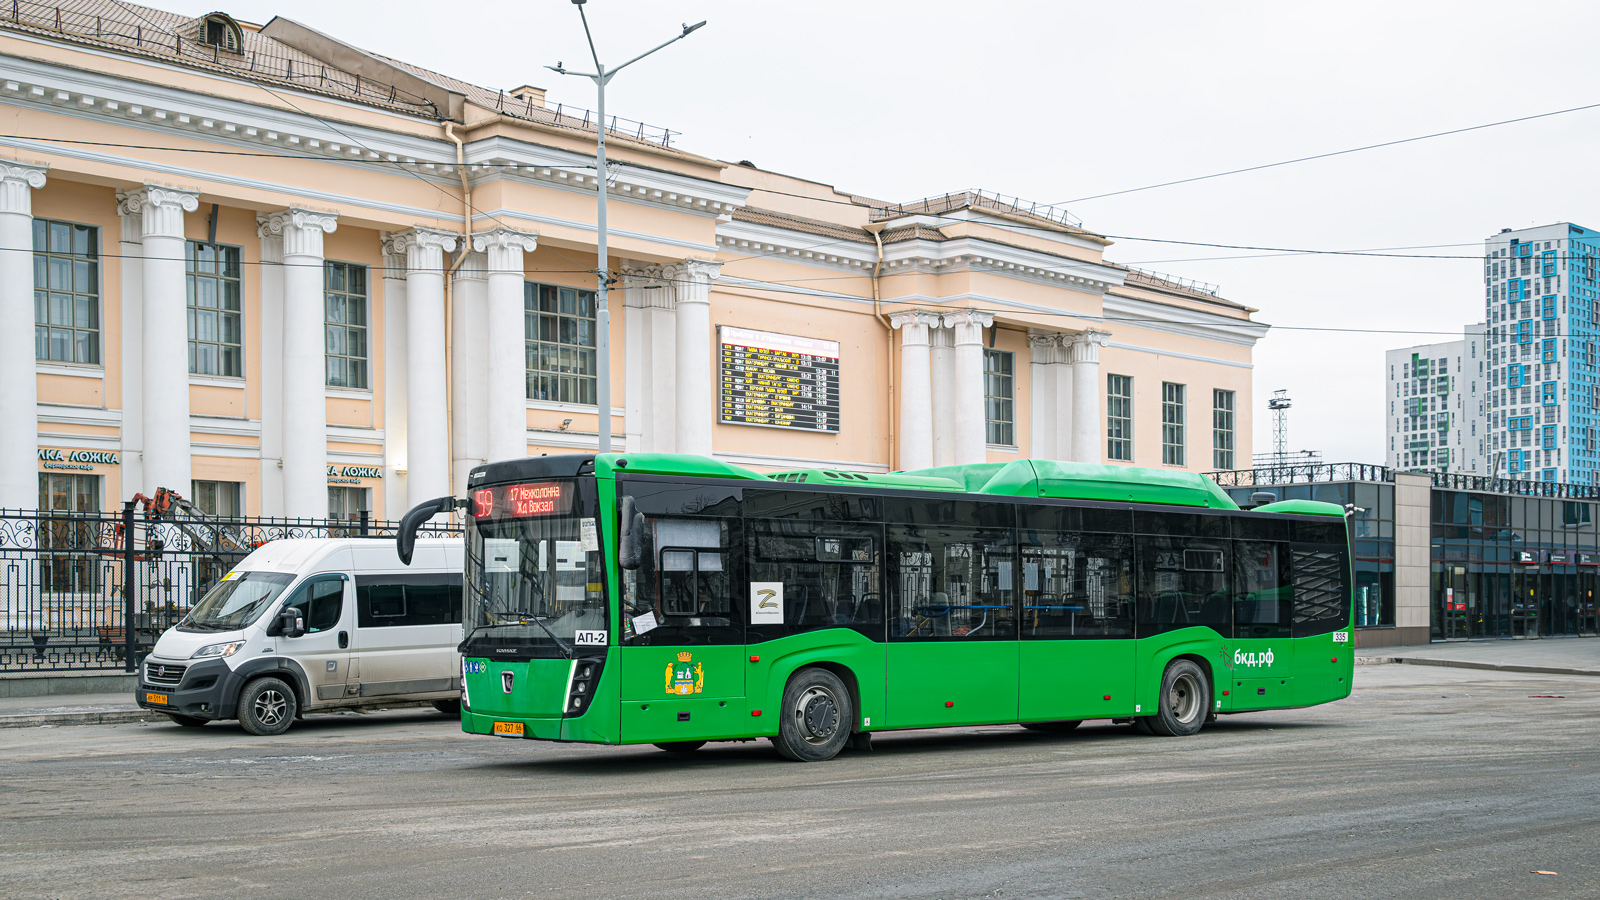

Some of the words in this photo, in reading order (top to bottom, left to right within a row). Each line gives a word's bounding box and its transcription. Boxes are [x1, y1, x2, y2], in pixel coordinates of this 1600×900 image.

[69, 451, 120, 464] ЛОЖКА
[341, 466, 382, 478] ЛОЖКА
[510, 488, 519, 501] 17
[475, 491, 493, 517] 59
[517, 501, 527, 514] Жд
[529, 499, 554, 513] Вокзал
[576, 630, 605, 643] АП-2
[1335, 633, 1346, 642] 335
[1234, 648, 1274, 668] бкд.рф
[503, 723, 513, 731] 327
